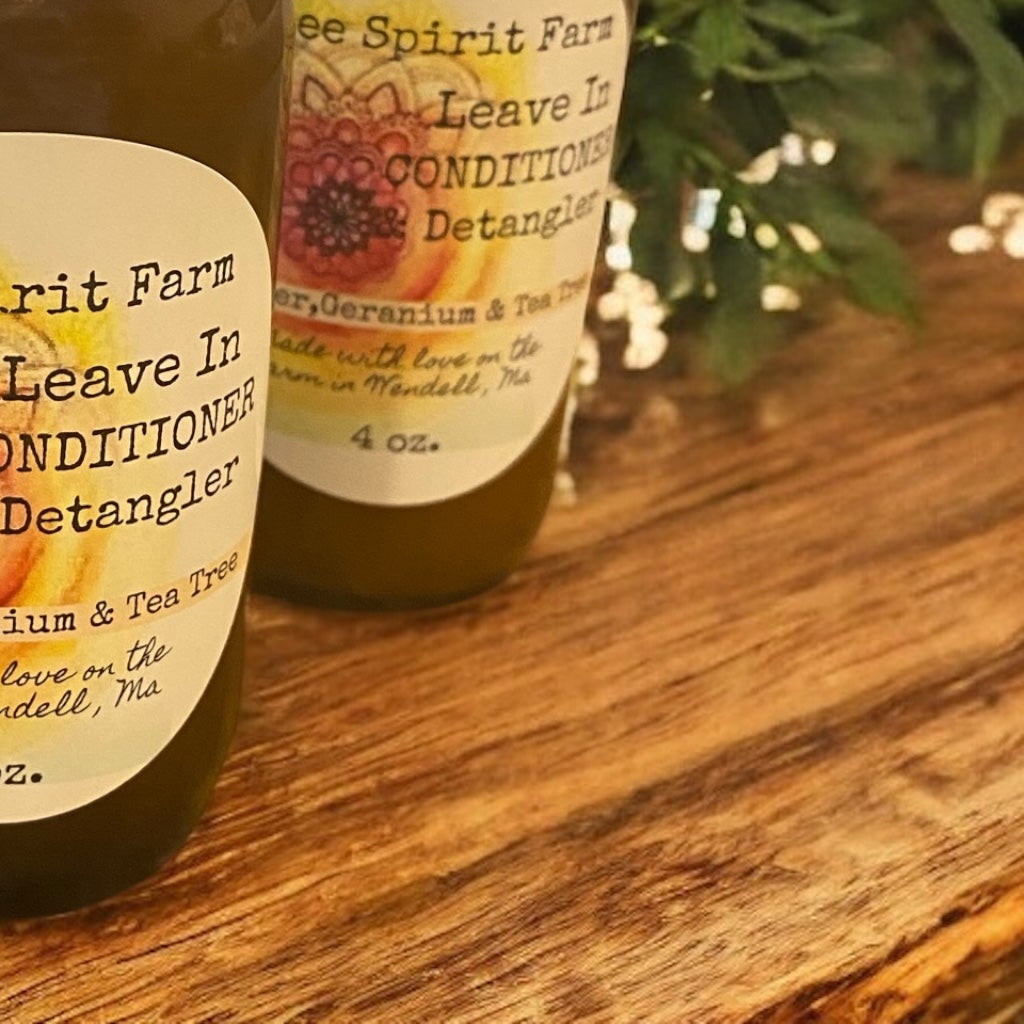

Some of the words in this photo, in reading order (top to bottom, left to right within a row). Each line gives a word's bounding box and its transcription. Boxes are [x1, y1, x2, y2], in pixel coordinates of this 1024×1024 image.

[298, 14, 345, 45] ee
[362, 15, 525, 61] Spirit
[537, 14, 613, 52] Farm
[434, 90, 571, 130] Leave
[579, 74, 611, 115] In
[425, 188, 601, 243] Detangler
[127, 252, 235, 307] Farm
[485, 298, 504, 322] &
[2, 352, 181, 403] Leave
[196, 325, 242, 378] In
[271, 329, 331, 358] ade
[337, 343, 402, 369] with
[413, 347, 472, 369] love
[350, 424, 373, 451] 4
[386, 433, 440, 454] oz.
[0, 453, 240, 538] Detangler
[90, 600, 115, 628] &
[126, 586, 181, 621] Tea
[188, 550, 240, 598] Tree
[0, 657, 79, 687] love
[82, 660, 115, 681] on
[126, 635, 173, 672] the
[114, 676, 163, 708] Ma
